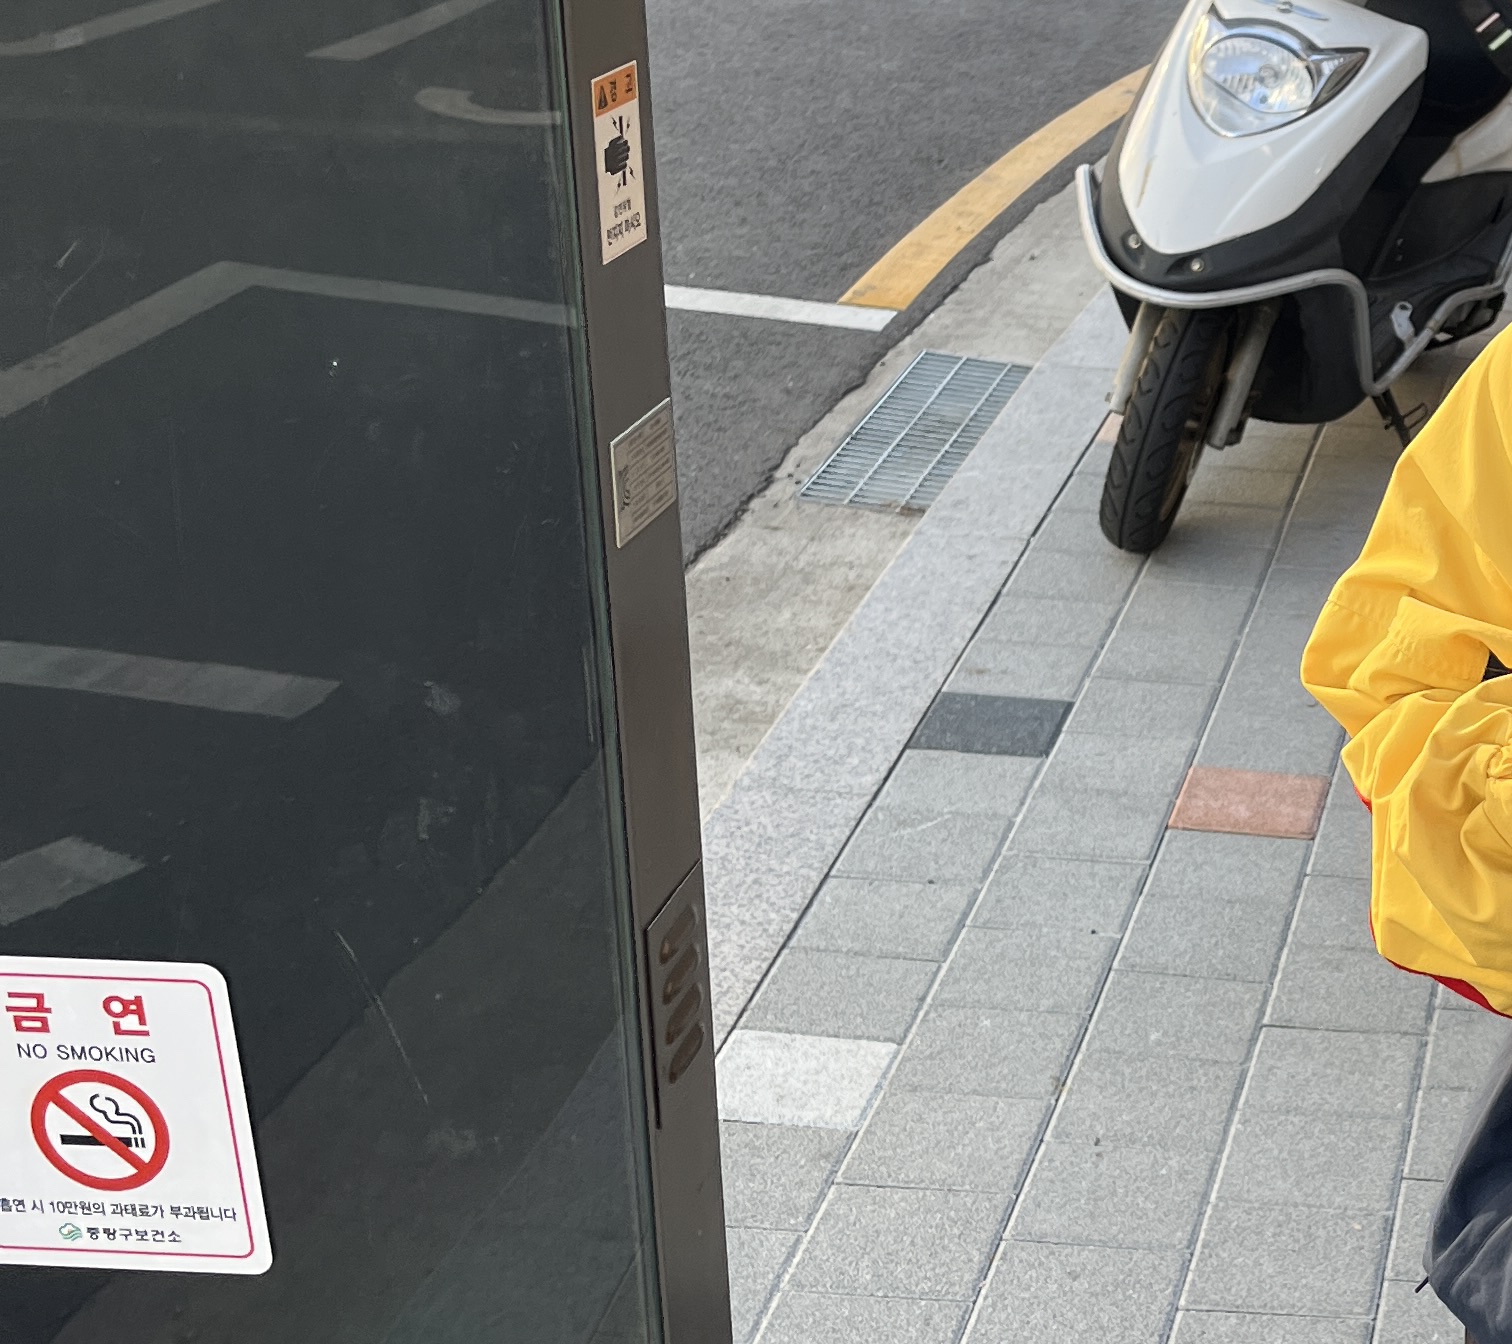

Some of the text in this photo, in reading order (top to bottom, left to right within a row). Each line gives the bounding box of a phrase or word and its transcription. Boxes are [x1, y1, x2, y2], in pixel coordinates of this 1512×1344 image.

[17, 1043, 157, 1064] NO SMOKING
[31, 1199, 45, 1214] 시
[50, 1200, 106, 1216] 10만원의
[111, 1203, 165, 1219] 과태료가
